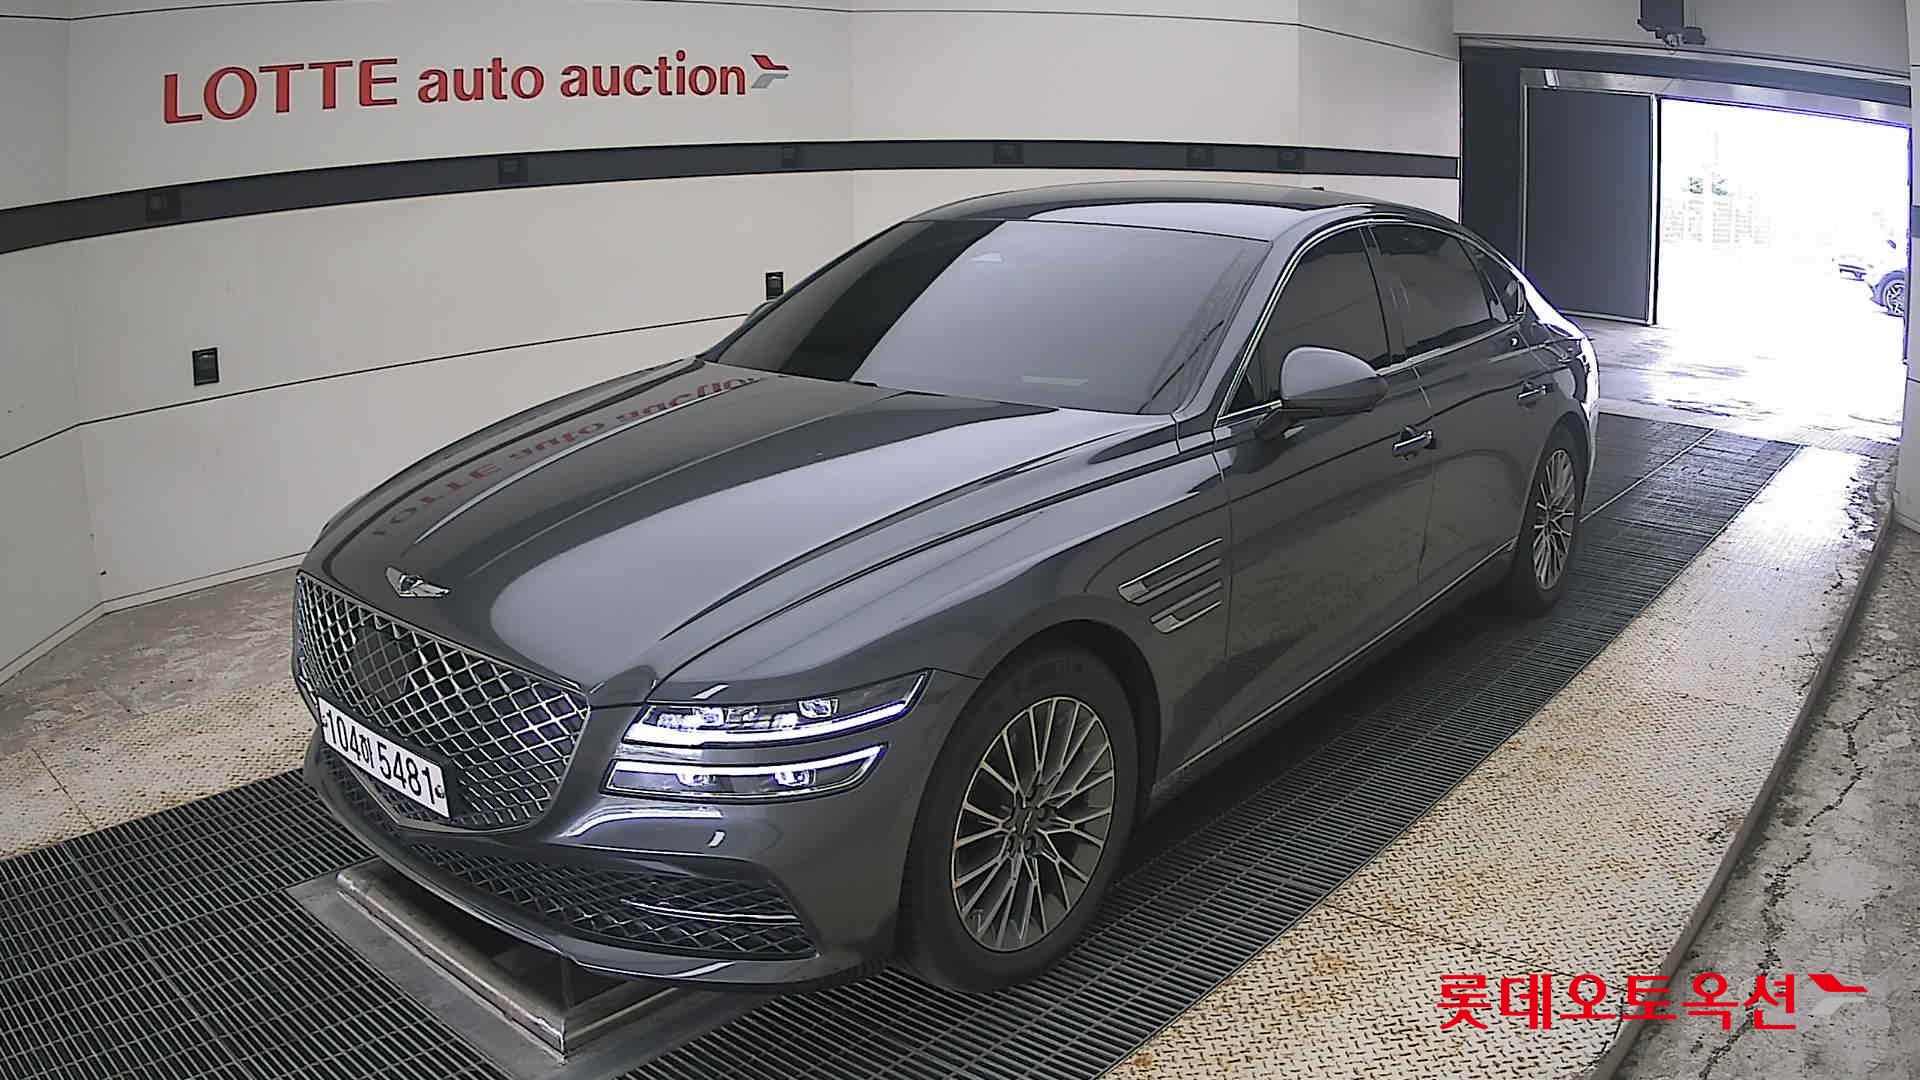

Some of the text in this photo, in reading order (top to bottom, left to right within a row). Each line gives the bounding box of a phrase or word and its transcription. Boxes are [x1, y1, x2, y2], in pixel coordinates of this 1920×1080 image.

[162, 50, 747, 124] LOTTE auto auction
[377, 741, 435, 805] 5481
